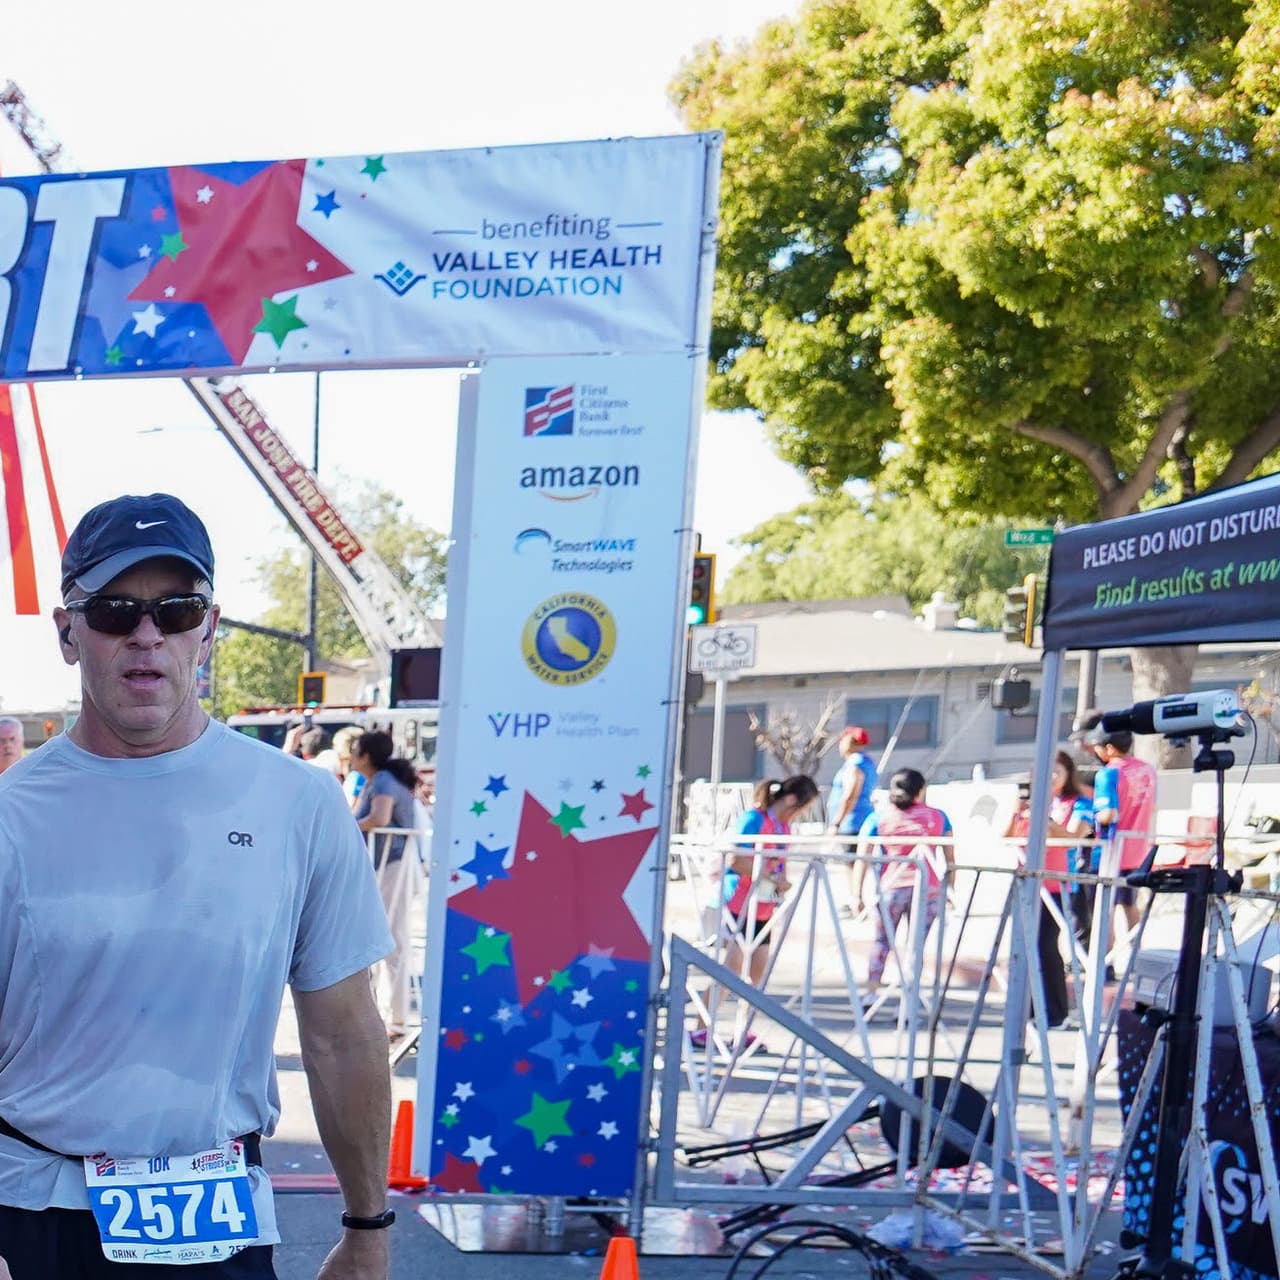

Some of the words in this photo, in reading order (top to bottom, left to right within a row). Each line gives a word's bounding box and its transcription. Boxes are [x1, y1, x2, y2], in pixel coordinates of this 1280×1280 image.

[481, 213, 611, 242] benefiting
[433, 250, 539, 273] VALLEY
[550, 245, 662, 270] HEALTH
[433, 275, 622, 299] FOUNDATION
[520, 465, 639, 488] amazon
[1083, 542, 1137, 570] PLEASE
[1140, 531, 1164, 557] DO
[1168, 521, 1207, 551] NOT
[1094, 576, 1137, 609] Find
[1140, 568, 1205, 603] results
[1210, 562, 1234, 591] at
[532, 595, 609, 621] CALIFORNIA
[526, 653, 560, 683] WATER
[488, 712, 551, 738] VHP
[227, 831, 254, 847] OR
[147, 1156, 170, 1174] 10K
[100, 1181, 246, 1240] 2574
[112, 1249, 138, 1259] DRINK
